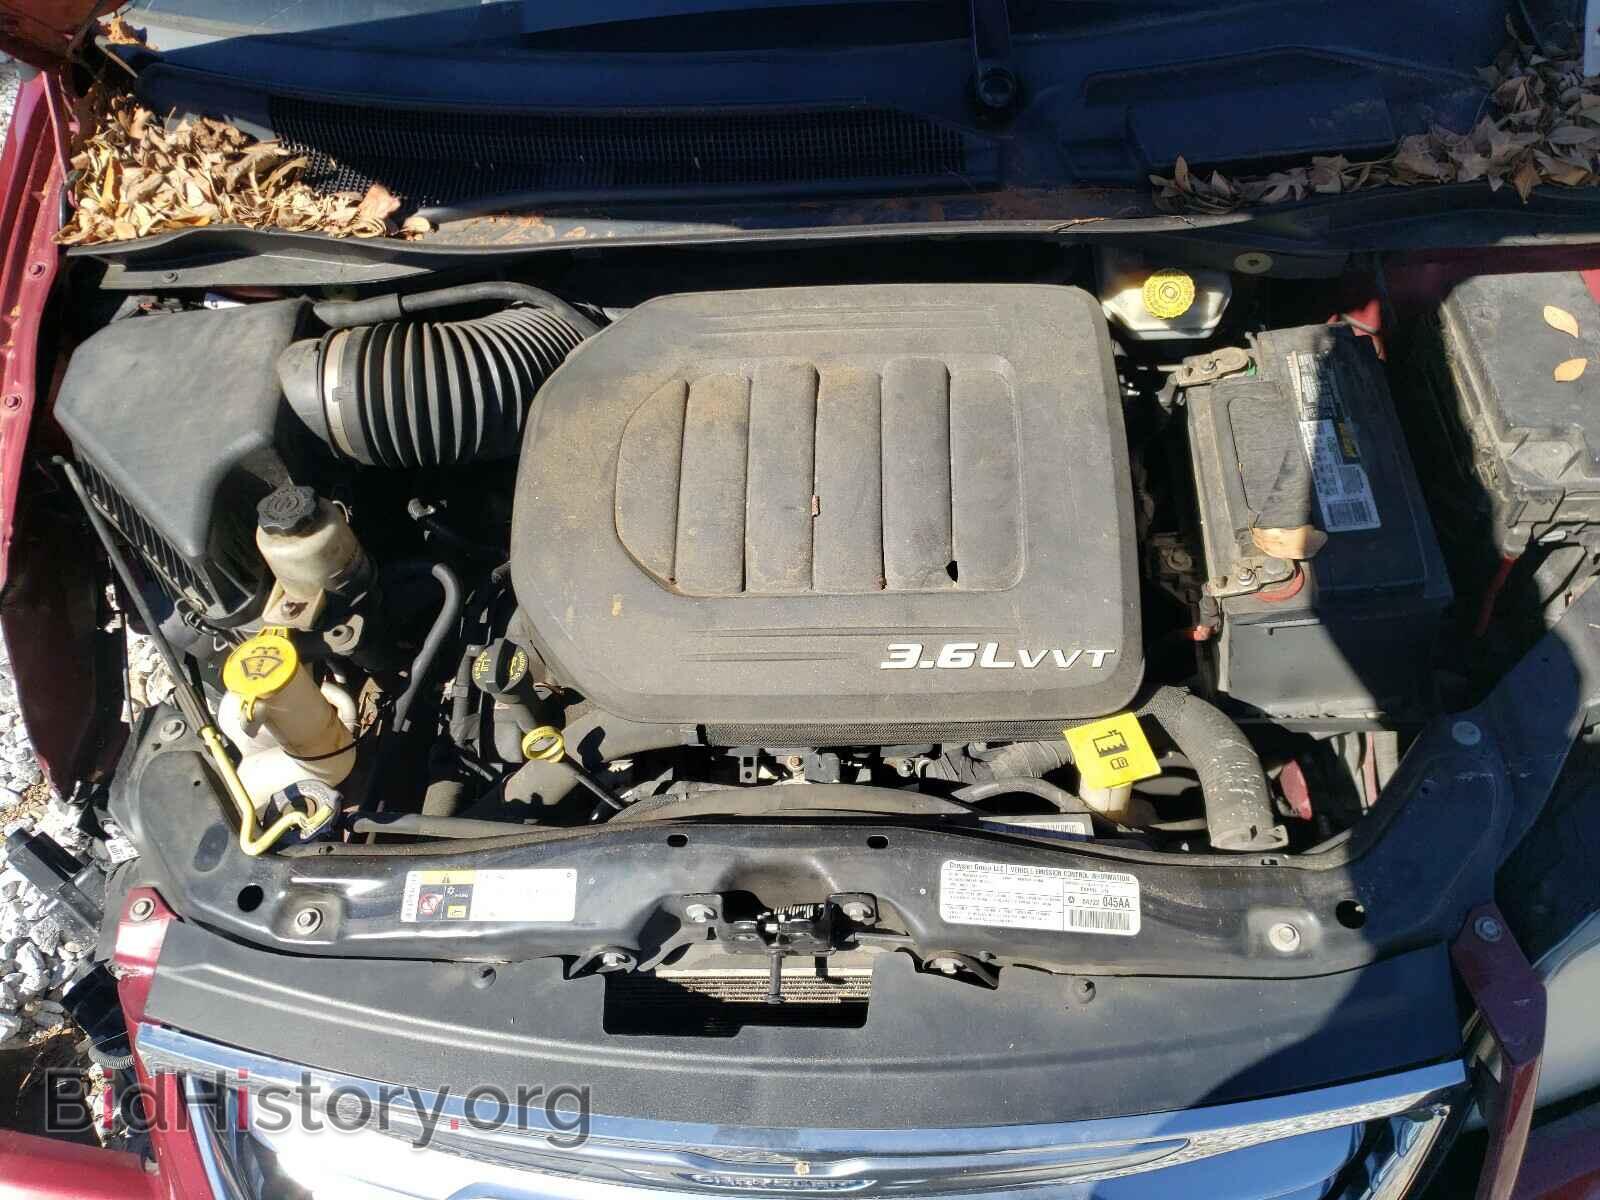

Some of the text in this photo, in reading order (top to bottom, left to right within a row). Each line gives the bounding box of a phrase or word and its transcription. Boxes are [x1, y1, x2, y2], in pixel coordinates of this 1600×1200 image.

[1035, 868, 1062, 877] EMISSION
[1063, 870, 1089, 879] CONTROL
[1091, 872, 1131, 882] INFORMATION
[1103, 896, 1130, 908] 045AA
